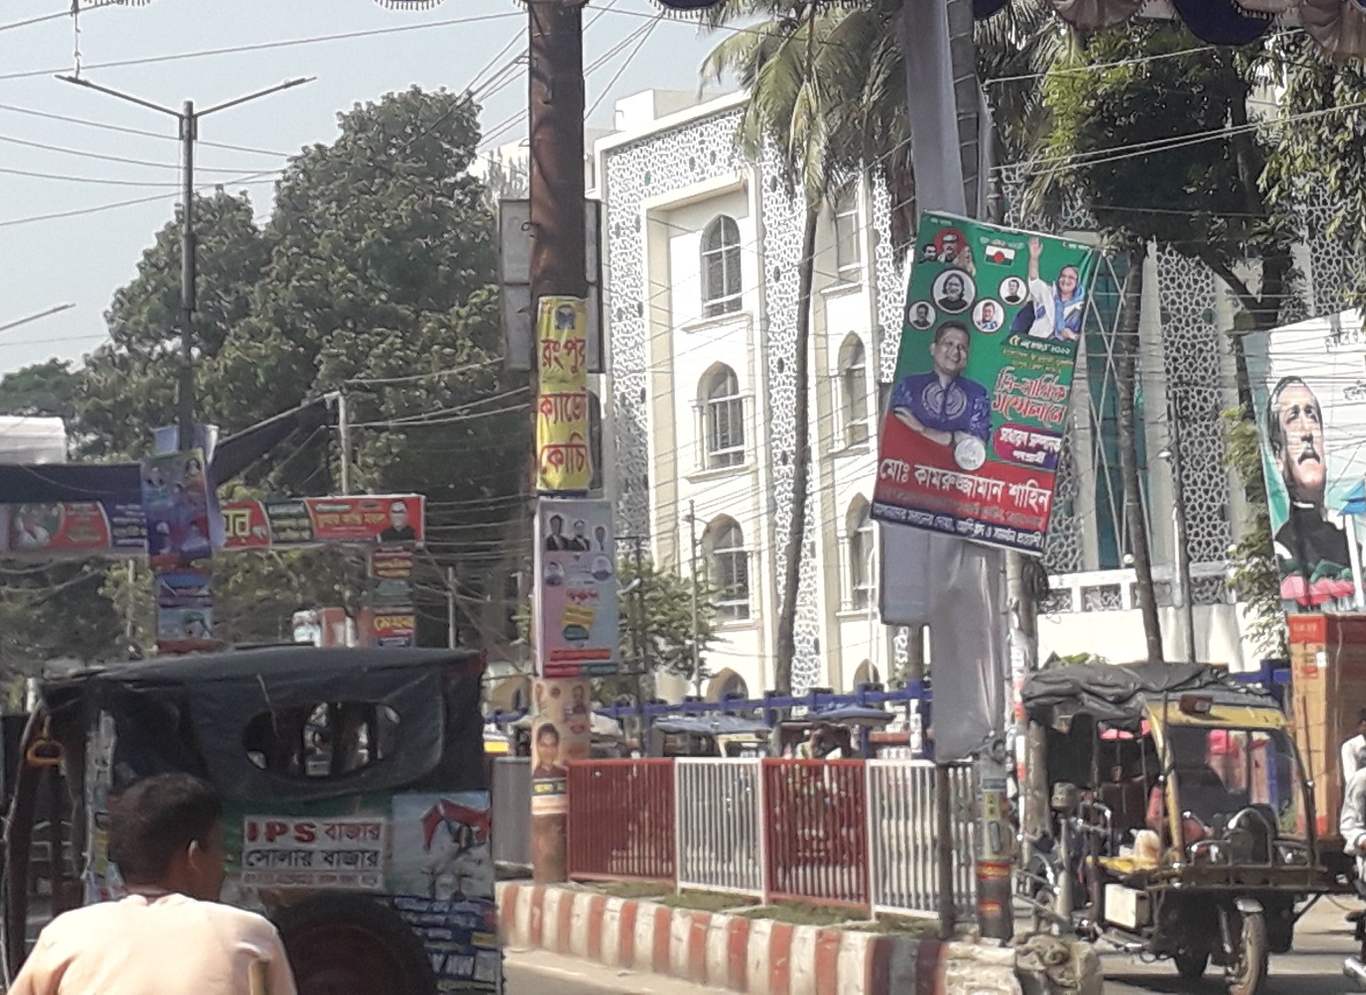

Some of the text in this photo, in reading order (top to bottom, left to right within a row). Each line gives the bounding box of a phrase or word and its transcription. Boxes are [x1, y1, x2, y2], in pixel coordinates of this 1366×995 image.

[541, 431, 586, 474] কোচি
[880, 458, 1052, 513] মোঃ কামরুজ্জামান শাহিন
[246, 820, 316, 843] IPS
[322, 822, 382, 842] বাজার
[245, 849, 381, 869] সোলার বাজার
